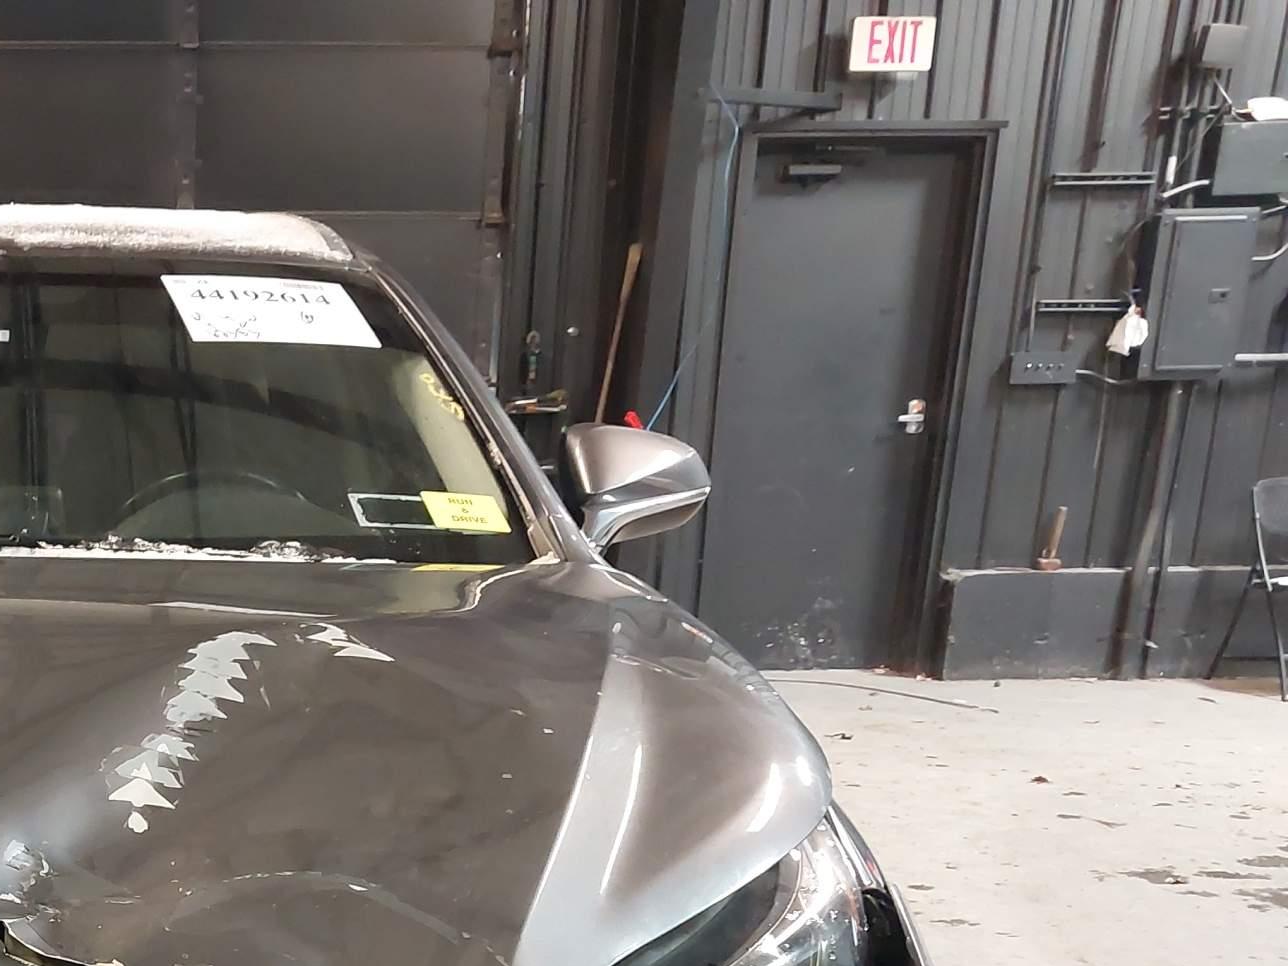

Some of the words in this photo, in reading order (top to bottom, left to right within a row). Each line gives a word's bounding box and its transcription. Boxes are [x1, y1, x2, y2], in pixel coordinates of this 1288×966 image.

[867, 20, 923, 64] EXIT
[190, 288, 331, 305] 44192614
[447, 497, 473, 506] RUN
[451, 515, 489, 524] DRIVE
